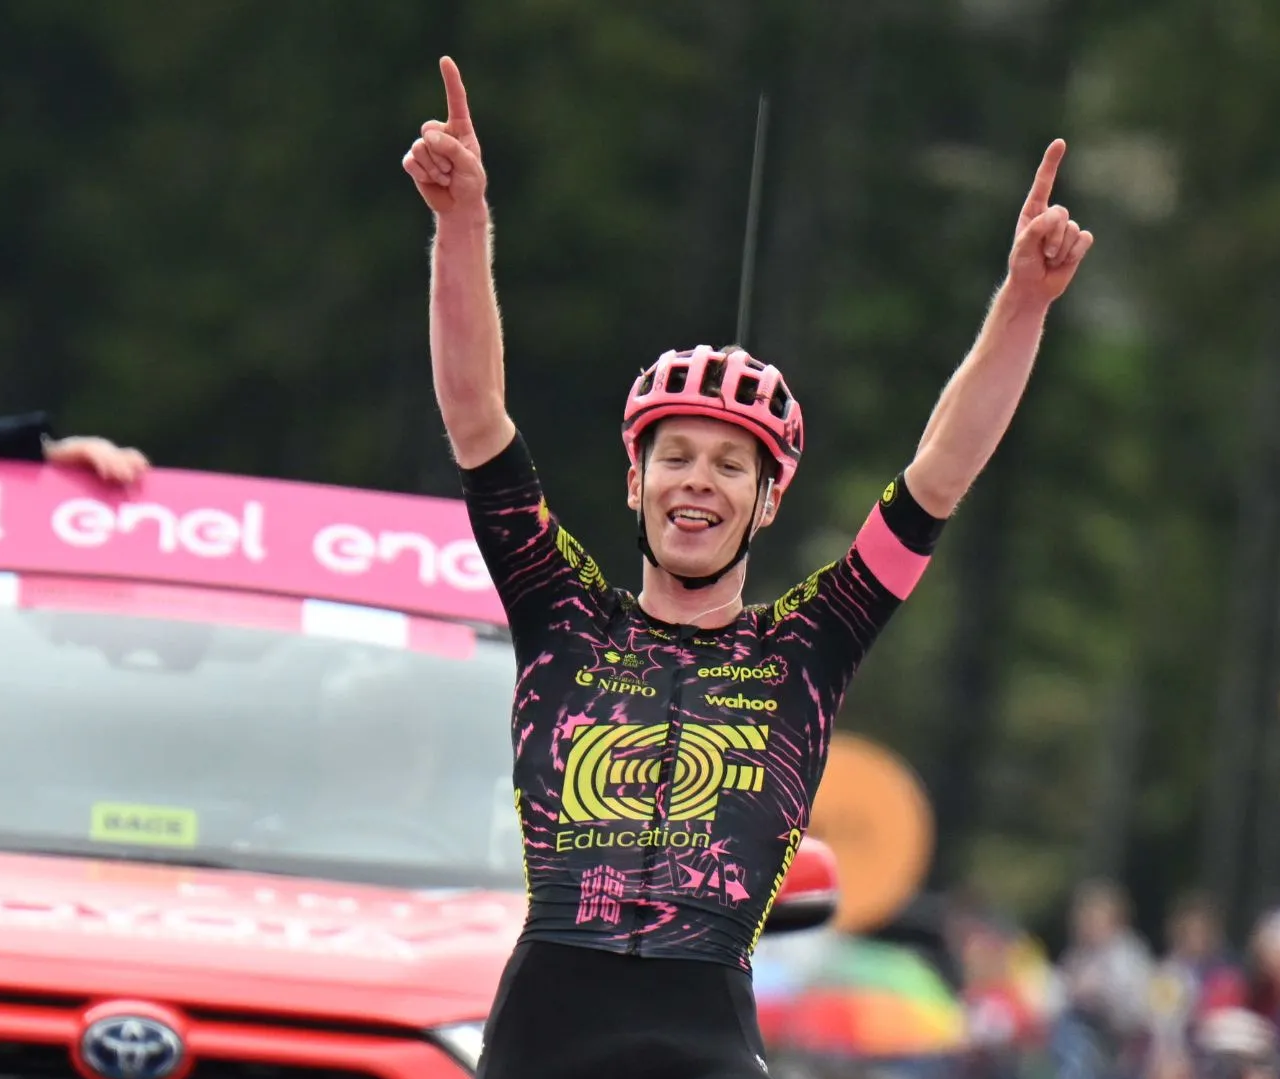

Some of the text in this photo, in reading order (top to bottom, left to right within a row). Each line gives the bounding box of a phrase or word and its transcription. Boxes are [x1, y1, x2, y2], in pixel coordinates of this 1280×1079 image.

[51, 502, 267, 561] enel
[312, 524, 498, 591] ene
[698, 664, 780, 682] easypost
[597, 678, 657, 697] NIPPO
[705, 693, 778, 711] wahoo
[556, 827, 711, 852] Education
